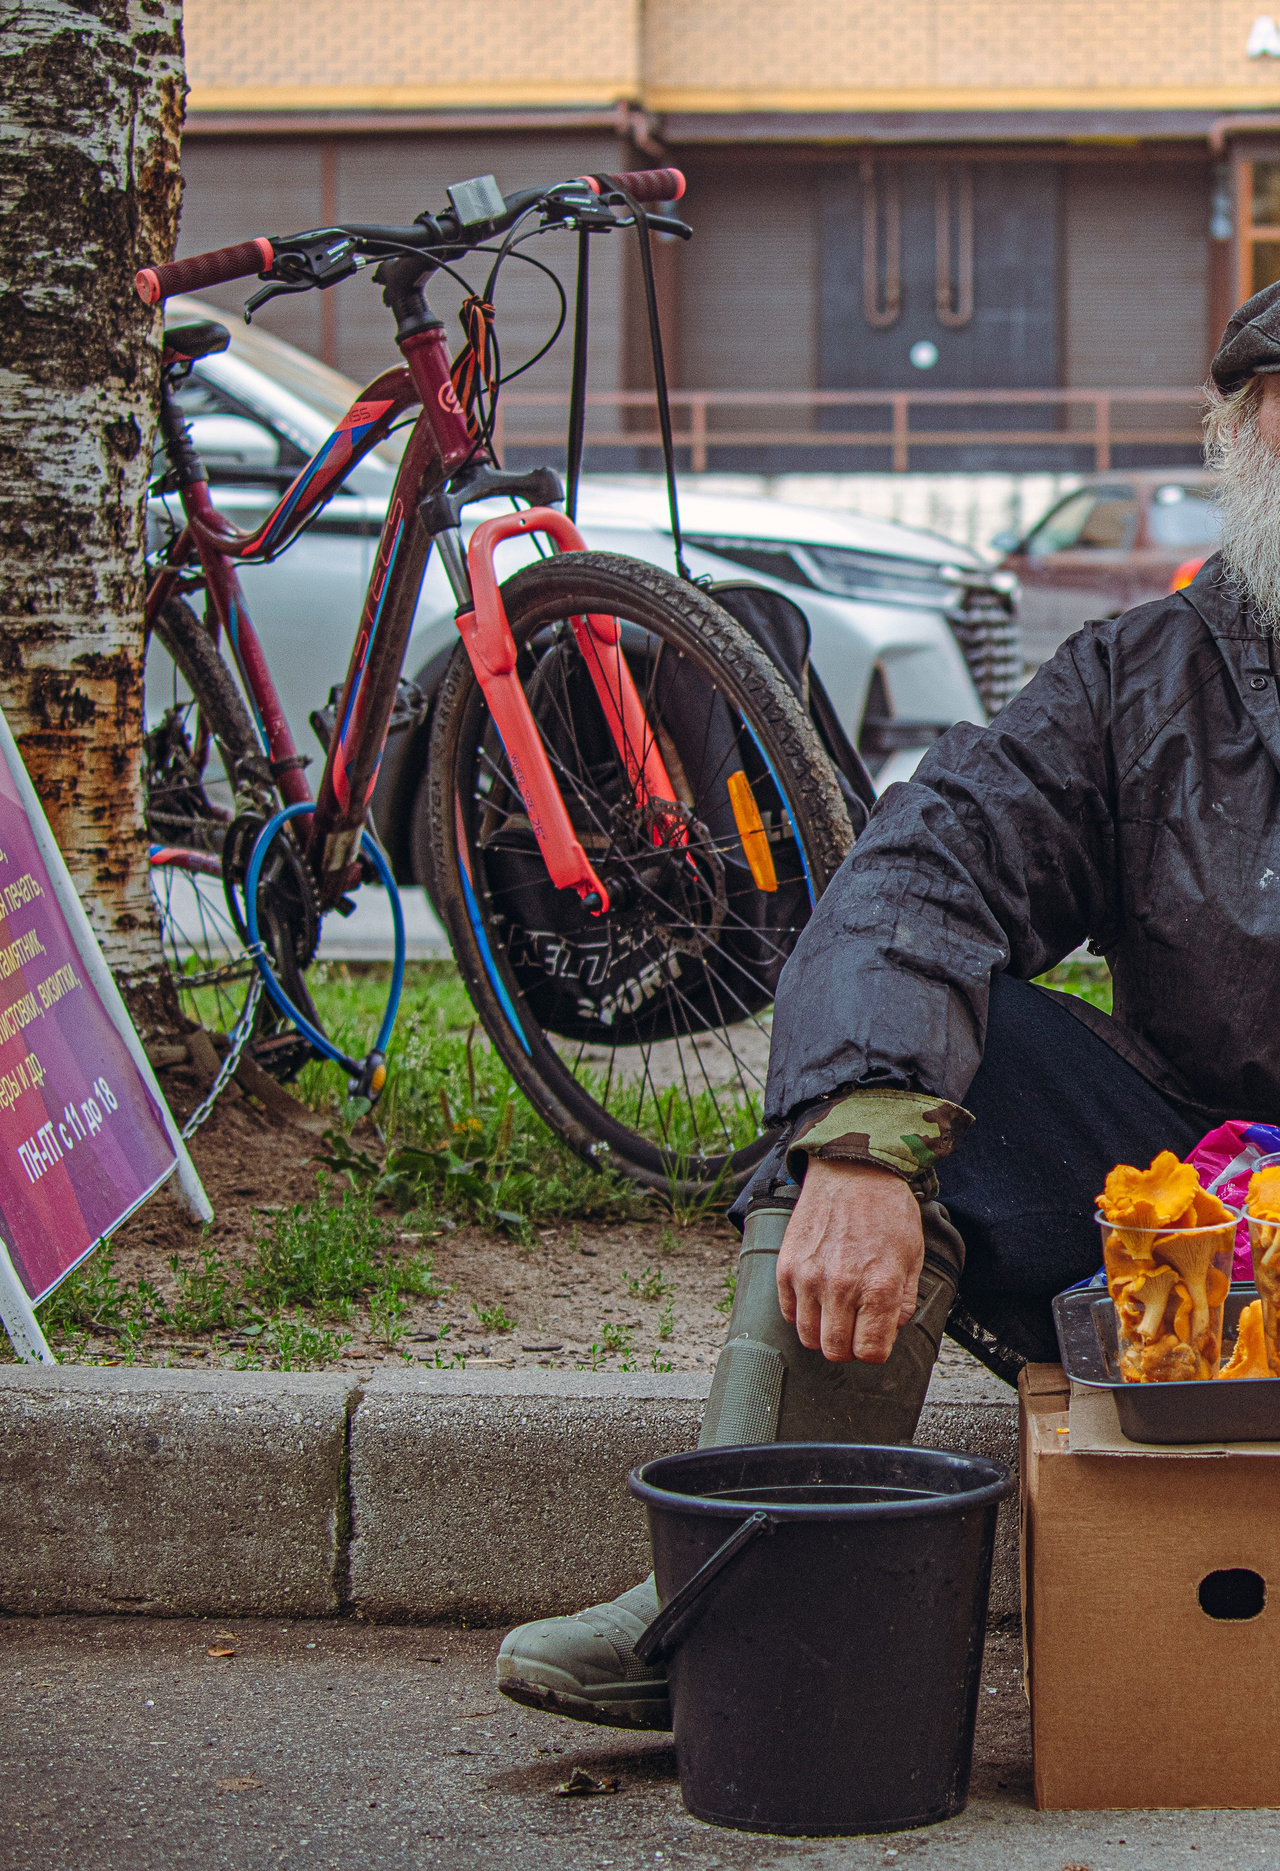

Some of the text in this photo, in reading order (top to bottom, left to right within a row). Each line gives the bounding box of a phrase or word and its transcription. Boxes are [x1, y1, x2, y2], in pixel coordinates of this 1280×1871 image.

[4, 873, 45, 912] печать,
[37, 963, 83, 1009] визитки,
[16, 1063, 30, 1090] и
[25, 1052, 47, 1090] др.
[17, 1121, 64, 1184] ПН-ПТ
[63, 1102, 87, 1141] 11
[80, 1097, 103, 1137] до
[93, 1076, 119, 1115] 18
